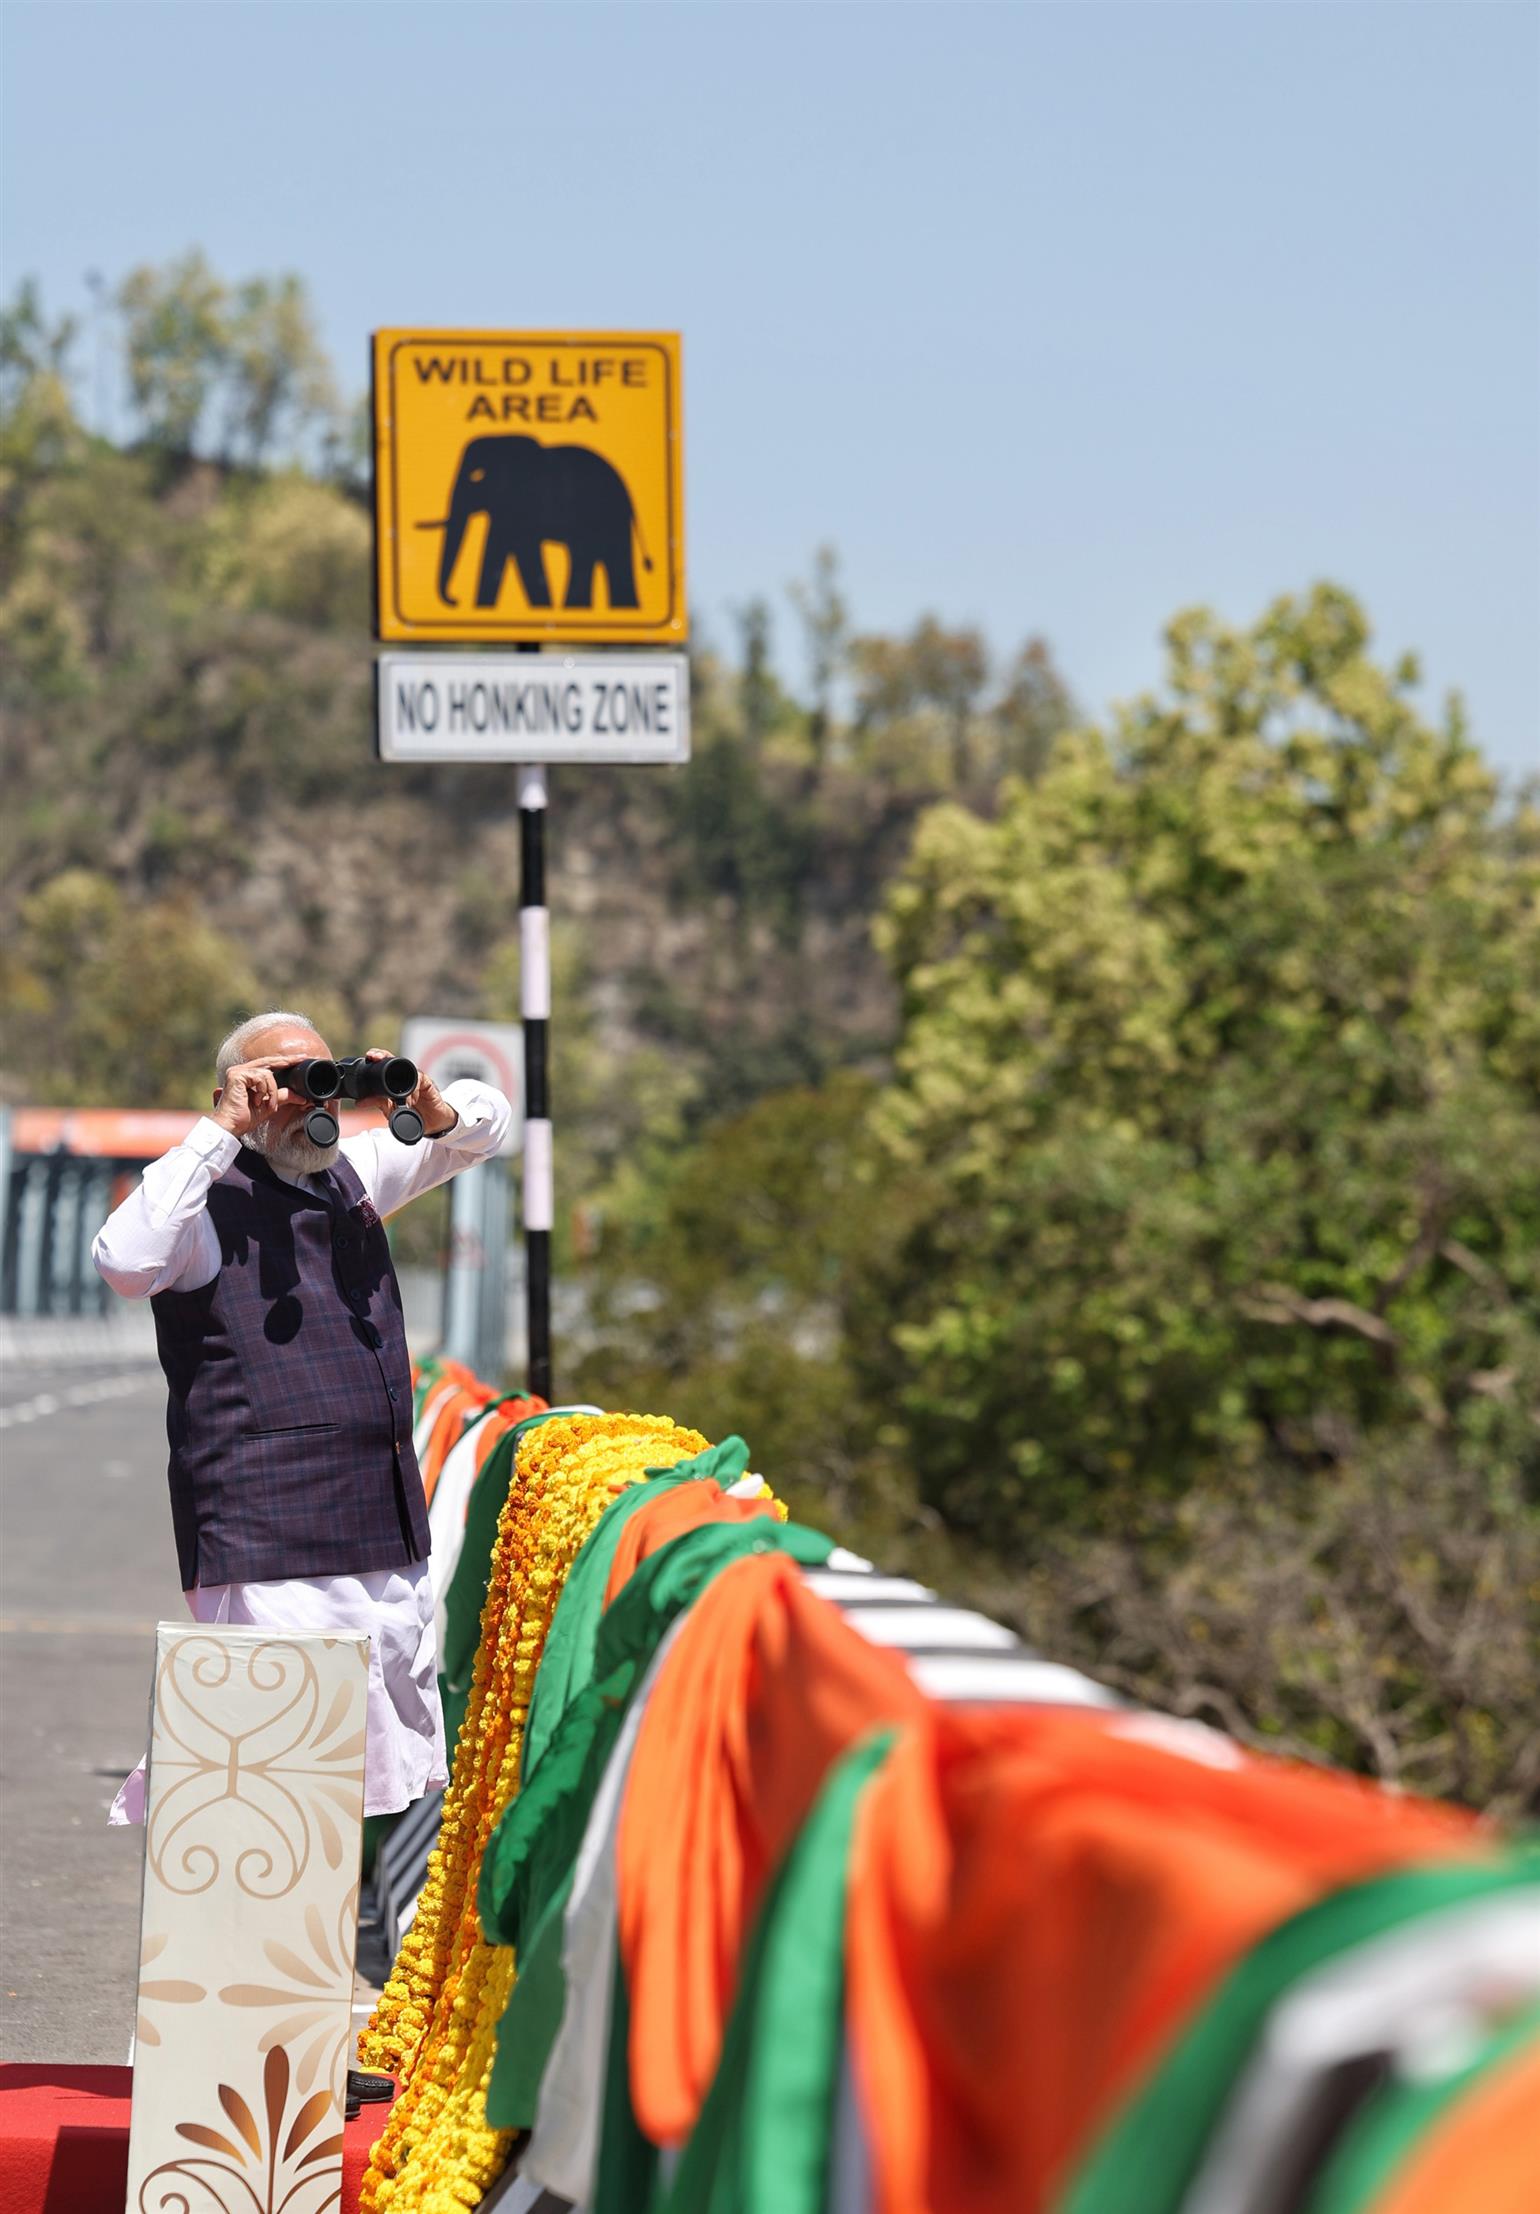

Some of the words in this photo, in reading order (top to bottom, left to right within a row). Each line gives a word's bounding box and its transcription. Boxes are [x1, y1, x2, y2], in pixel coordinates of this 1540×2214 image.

[413, 356, 532, 385] WILD
[550, 358, 647, 388] LIFE
[465, 392, 598, 423] AREA
[397, 682, 439, 734] NO
[449, 682, 582, 734] HONKING
[592, 683, 670, 734] ZONE
